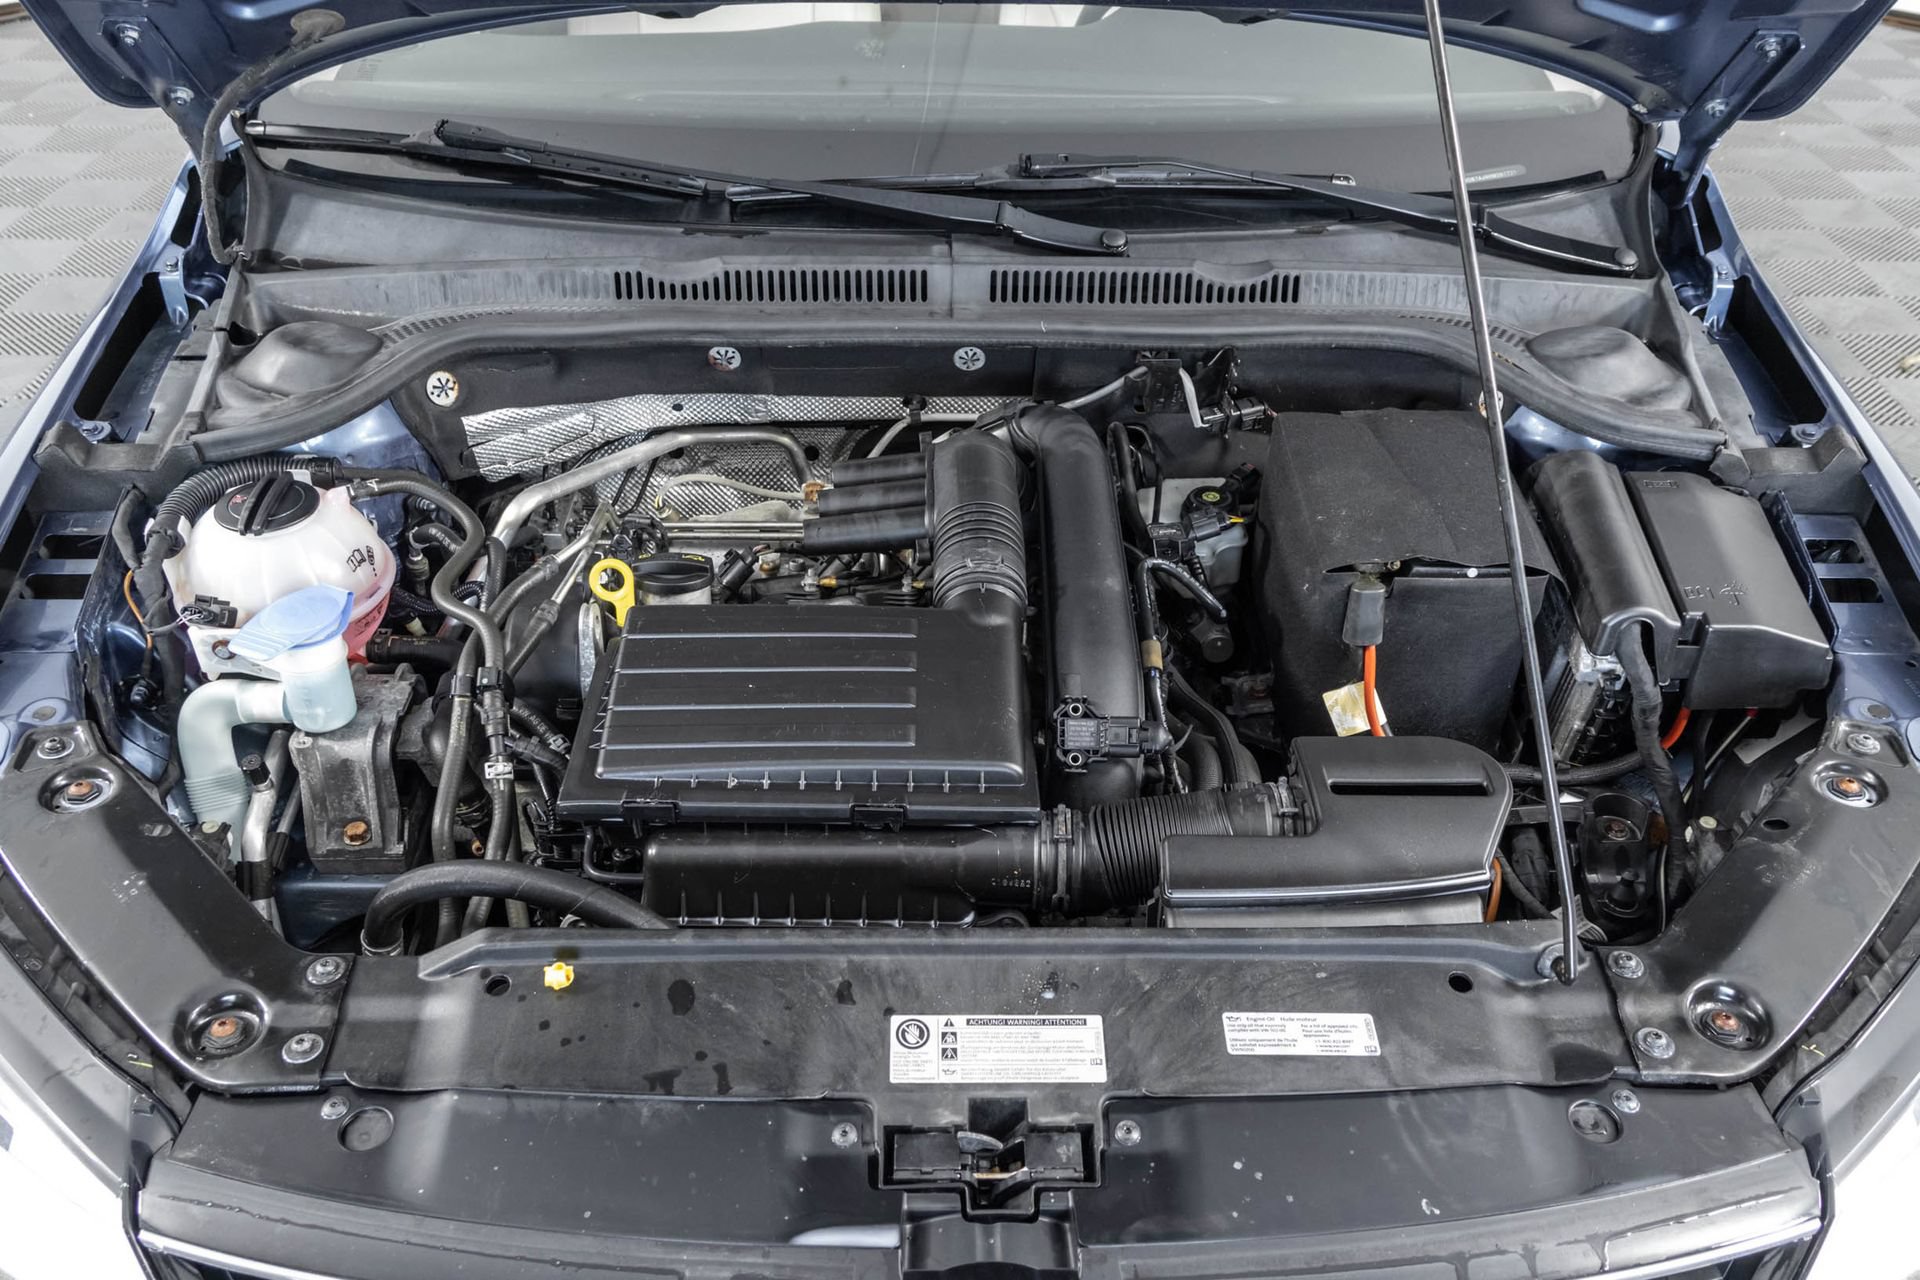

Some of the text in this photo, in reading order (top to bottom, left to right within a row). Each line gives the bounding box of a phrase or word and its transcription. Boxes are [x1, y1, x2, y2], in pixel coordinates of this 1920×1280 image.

[968, 1018, 1085, 1026] ACHTUNG! WARNING! ATTENTION!
